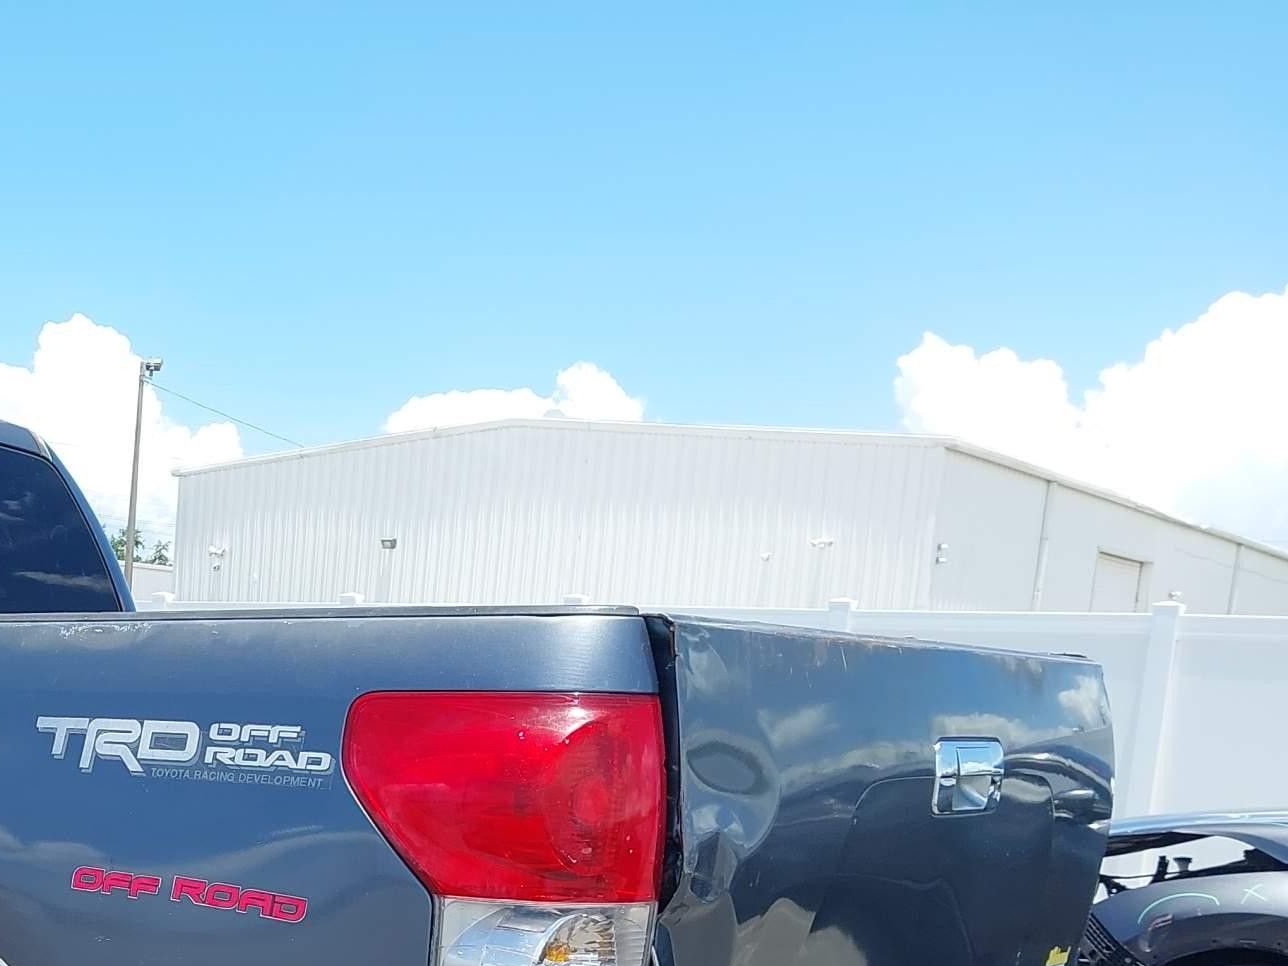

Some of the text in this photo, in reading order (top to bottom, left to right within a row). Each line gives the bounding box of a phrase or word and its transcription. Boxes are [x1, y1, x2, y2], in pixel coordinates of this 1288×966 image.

[36, 716, 201, 775] TRD
[208, 722, 304, 745] OFF
[204, 746, 335, 773] ROAD
[150, 767, 323, 788] TOYOTA RACING DEVELOPMENT
[70, 865, 309, 923] OFF ROAD
